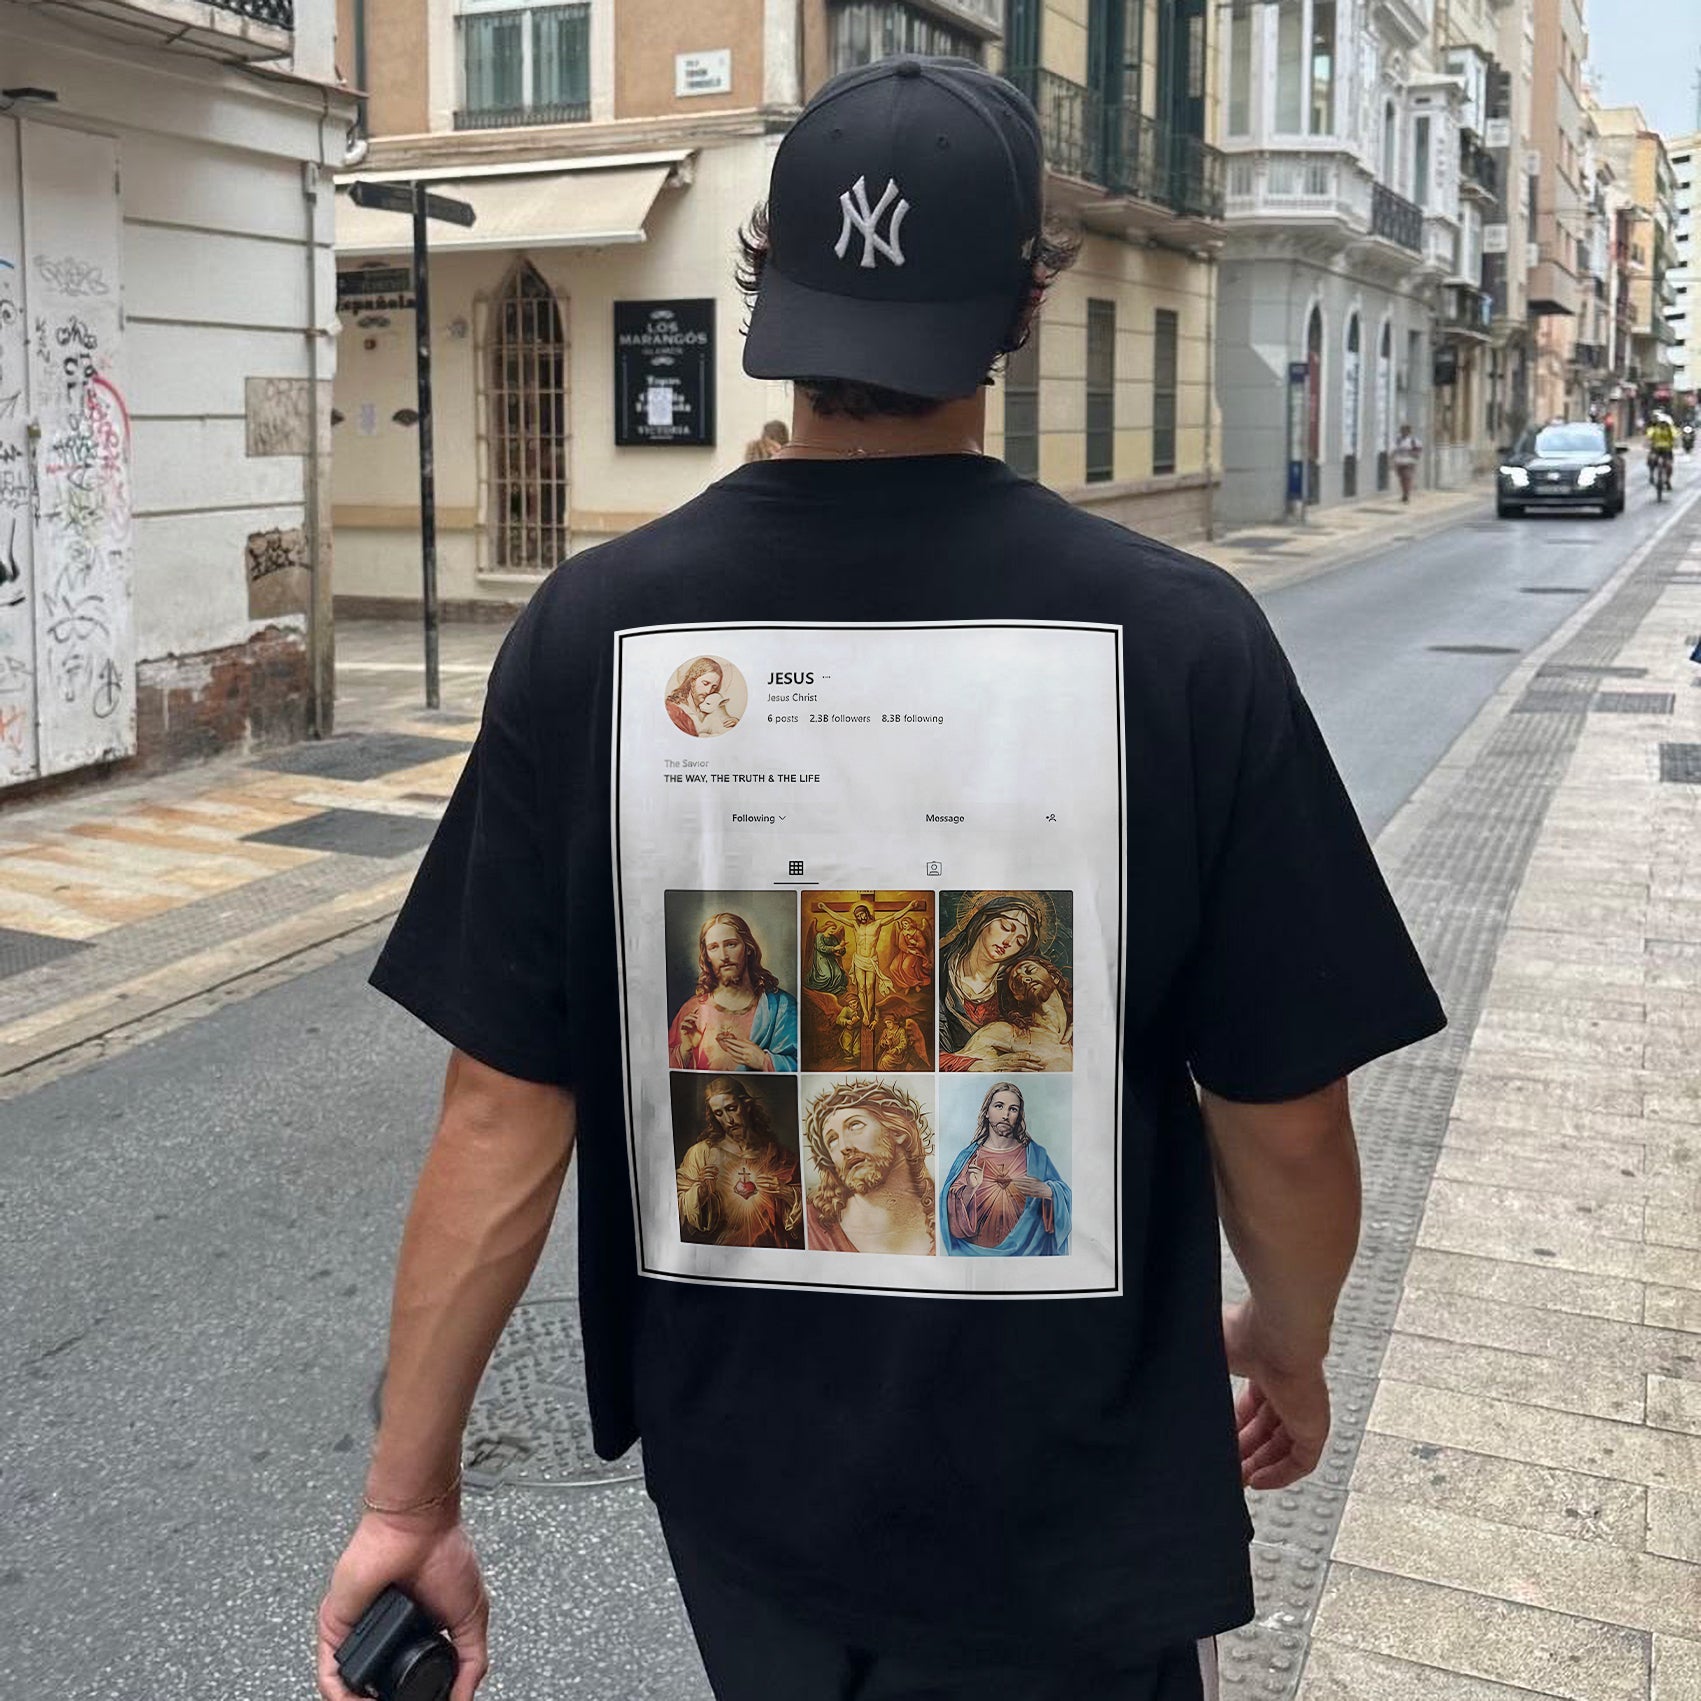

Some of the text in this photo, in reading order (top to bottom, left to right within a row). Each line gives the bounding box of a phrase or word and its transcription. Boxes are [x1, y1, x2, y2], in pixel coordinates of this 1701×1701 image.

[834, 175, 910, 268] NY
[647, 321, 678, 333] LOS
[767, 672, 815, 685] JESUS
[767, 693, 818, 703] Jesus Christ
[767, 713, 944, 725] 6 posts 2.3B followers 8.3B following
[664, 759, 710, 768] The Savior
[663, 774, 820, 784] THE WAY, THE TRUTH & THE LIFE
[732, 813, 965, 824] Following Message
